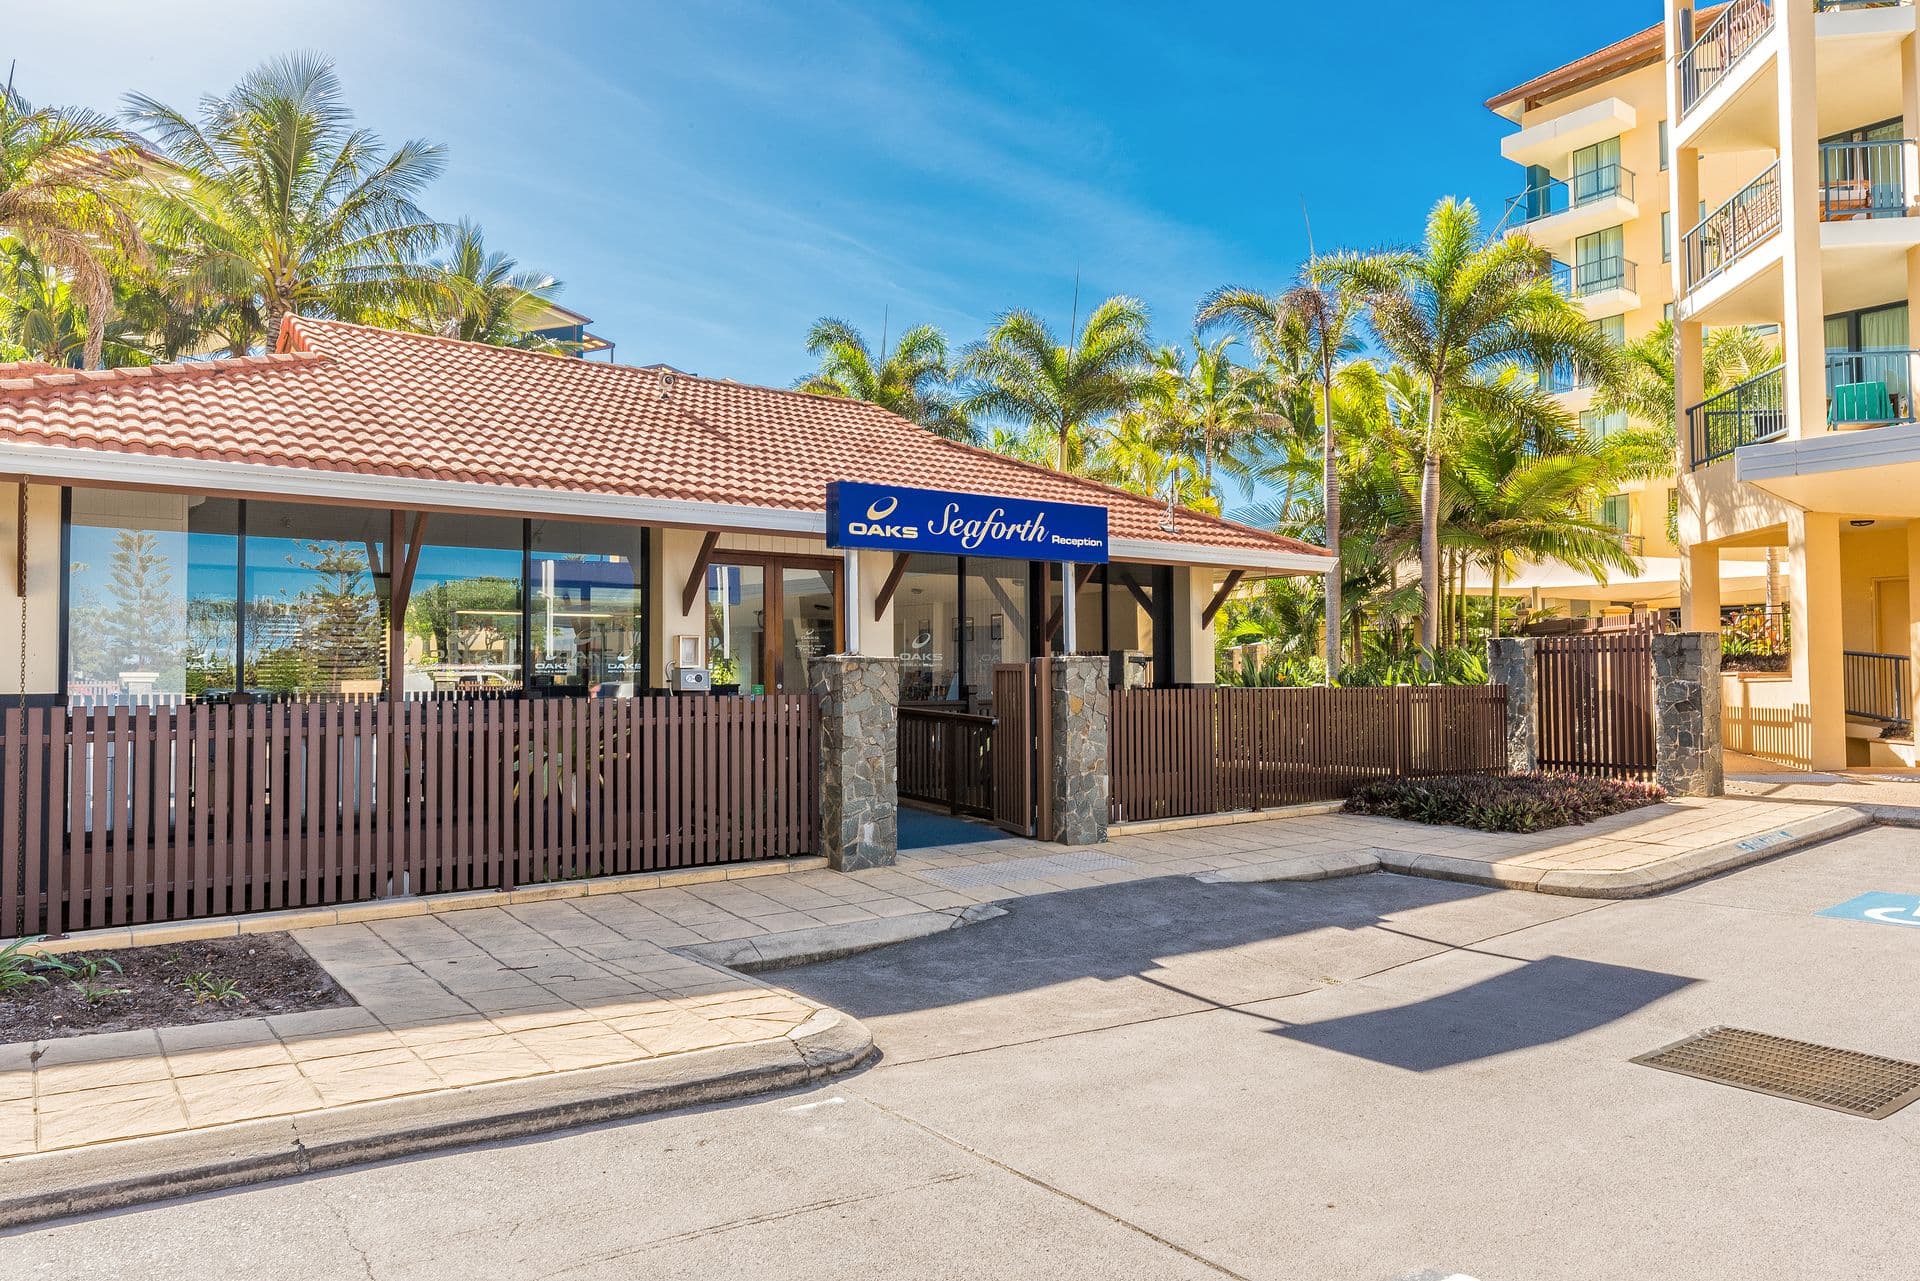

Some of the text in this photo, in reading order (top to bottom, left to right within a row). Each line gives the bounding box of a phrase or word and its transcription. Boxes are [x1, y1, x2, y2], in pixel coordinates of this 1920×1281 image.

[849, 522, 918, 539] OAKS
[927, 502, 1102, 549] Seaforth Reception
[900, 653, 943, 661] OAKS
